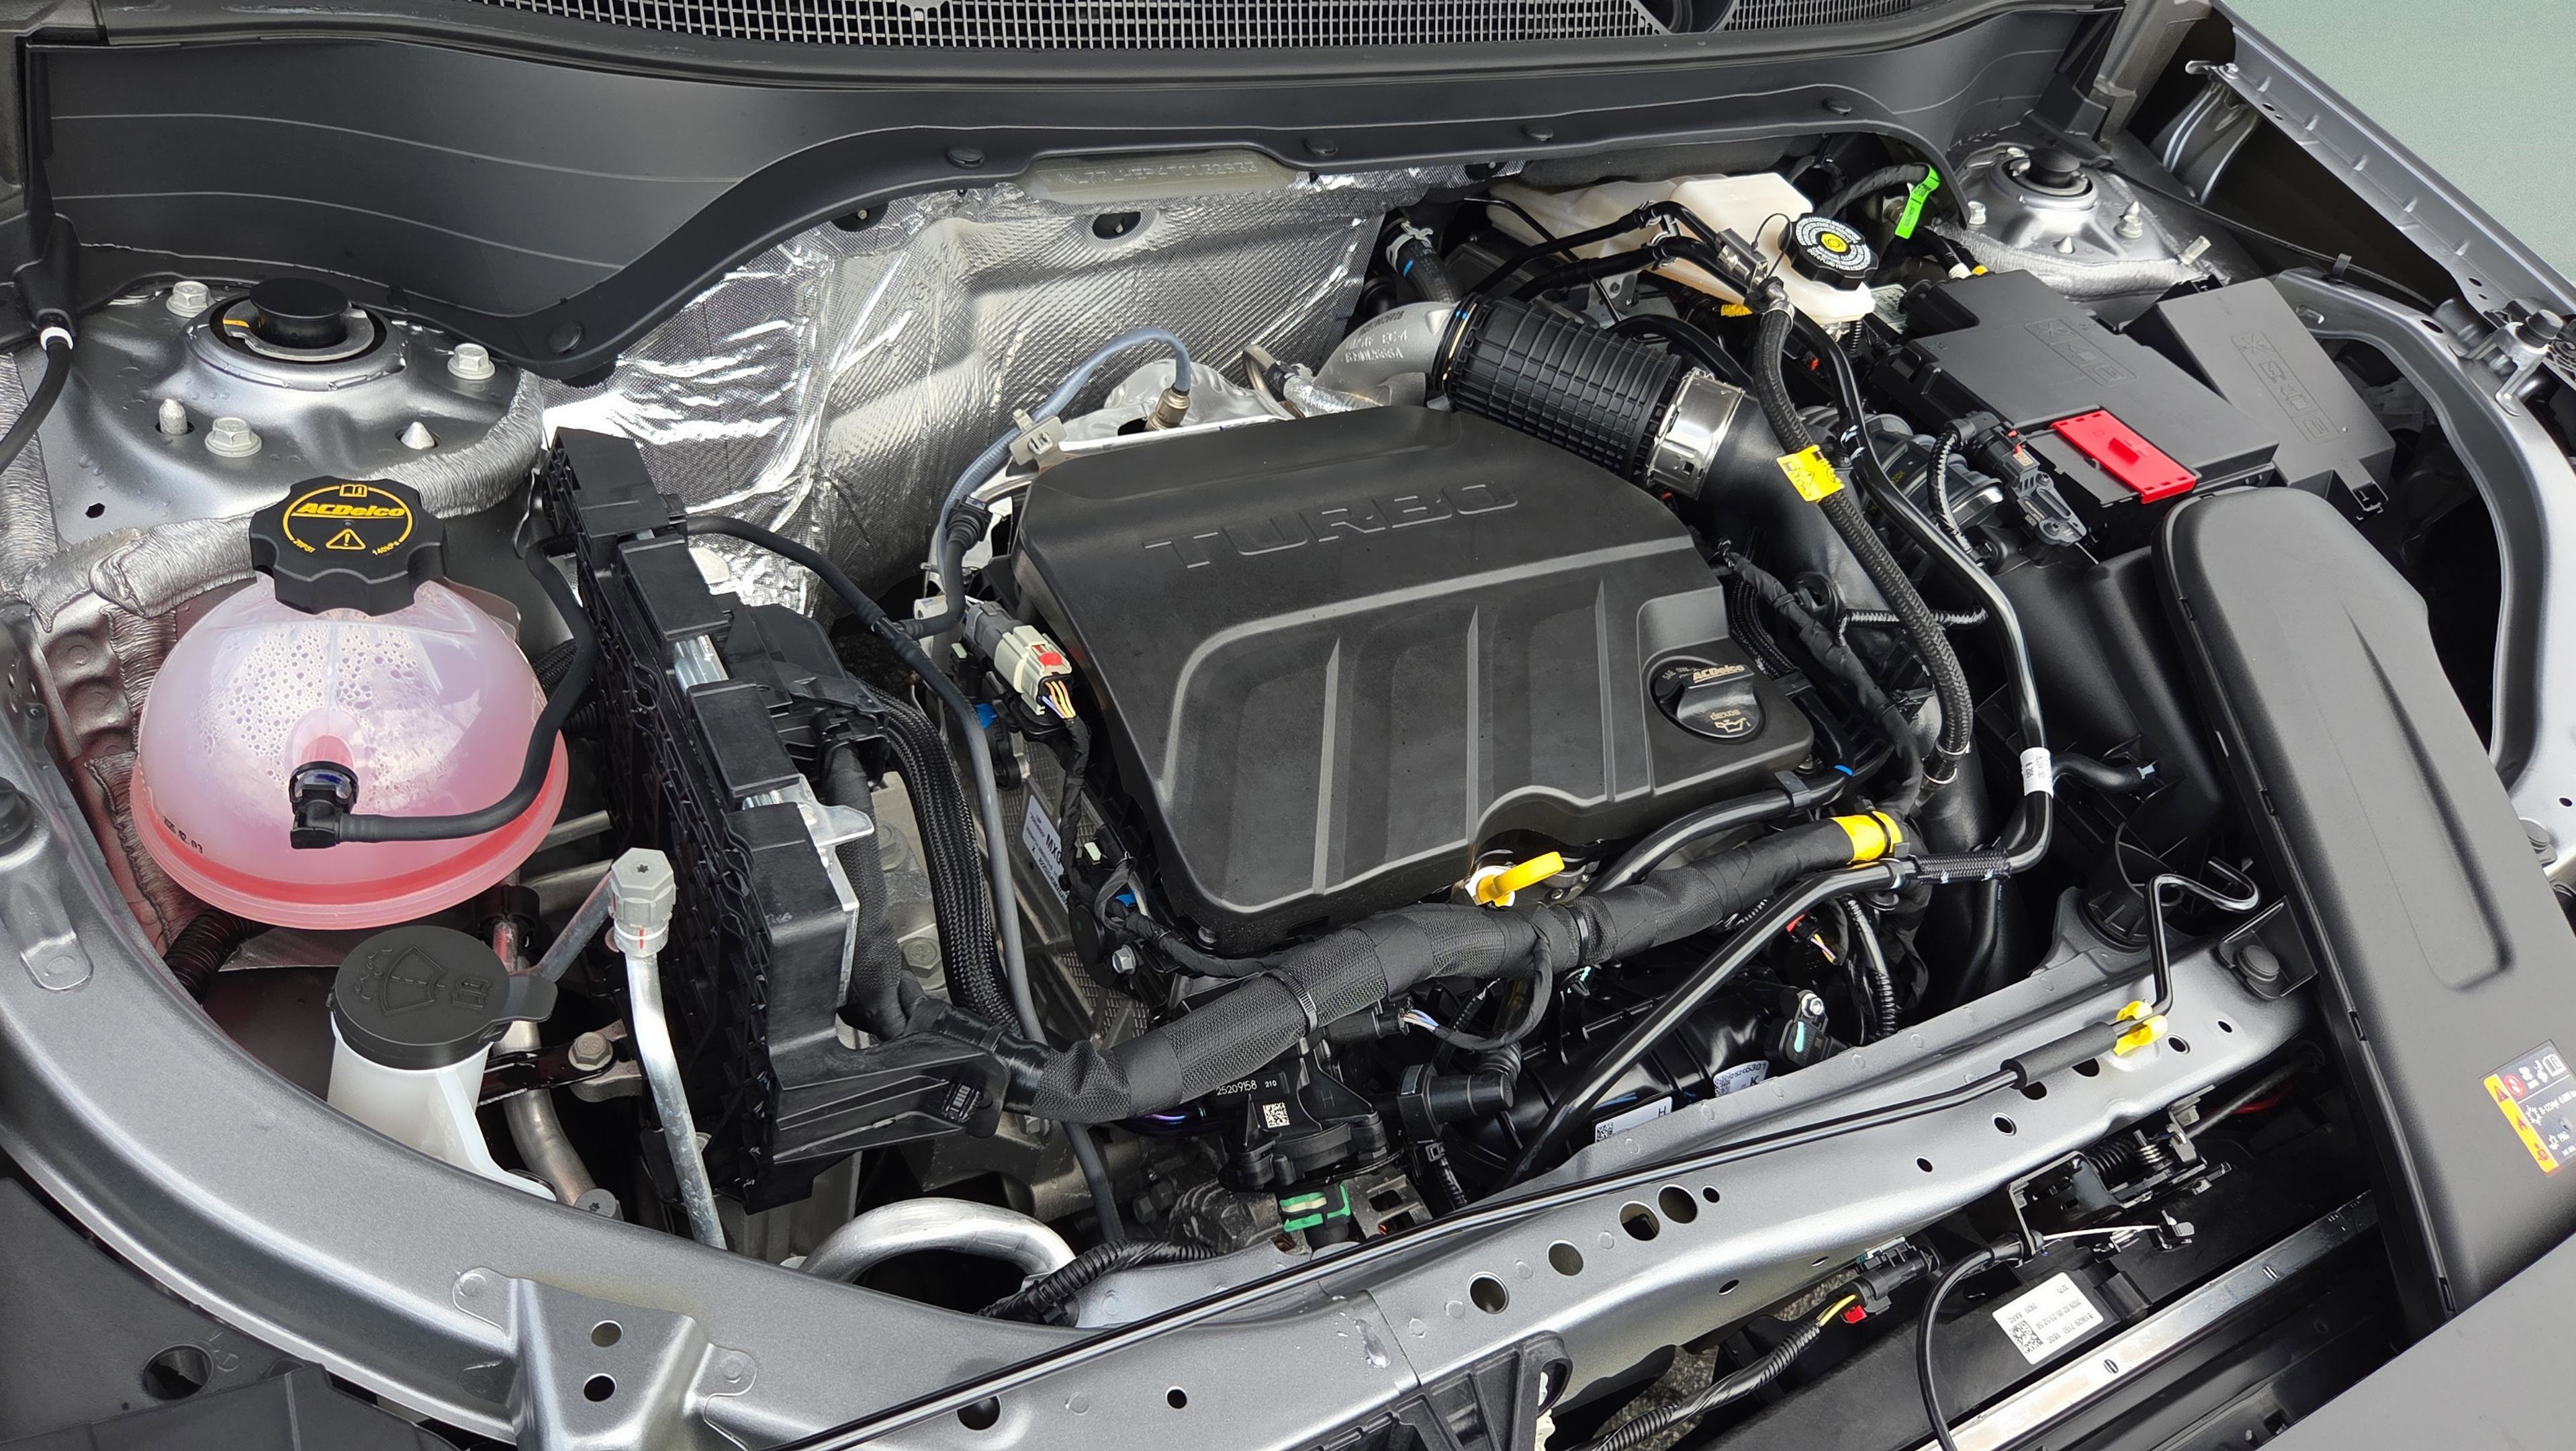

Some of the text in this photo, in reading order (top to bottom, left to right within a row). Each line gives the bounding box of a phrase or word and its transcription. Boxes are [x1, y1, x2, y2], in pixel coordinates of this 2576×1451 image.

[296, 502, 406, 517] ACDelco
[1143, 484, 1518, 569] TURBO
[1692, 664, 1745, 681] ACDelco
[1215, 1080, 1277, 1096] 25209158 210
